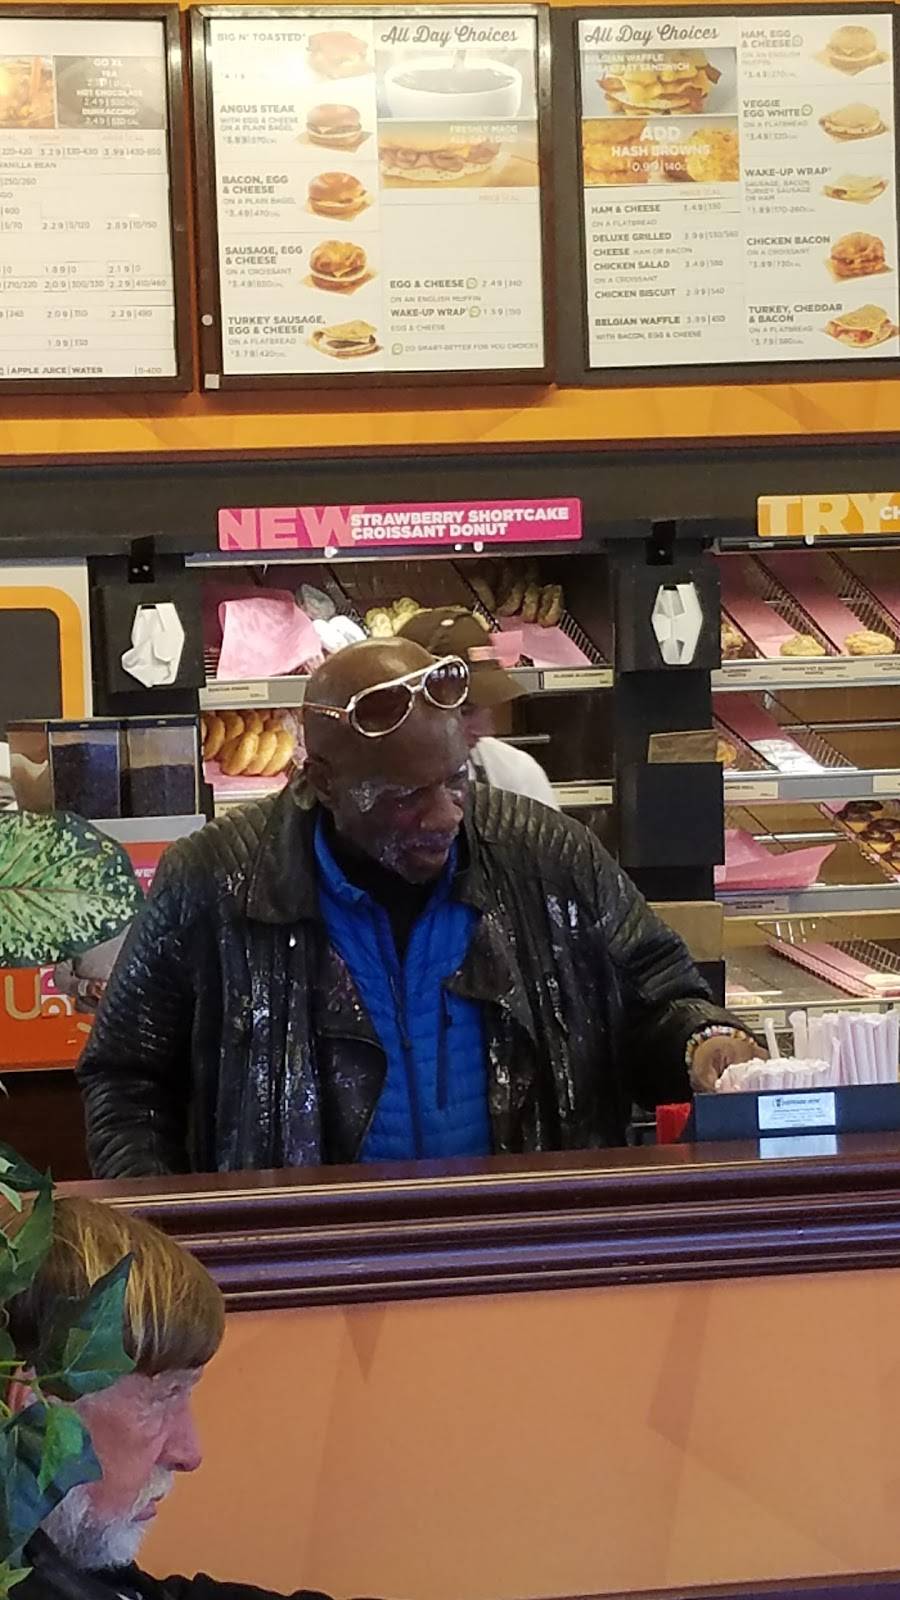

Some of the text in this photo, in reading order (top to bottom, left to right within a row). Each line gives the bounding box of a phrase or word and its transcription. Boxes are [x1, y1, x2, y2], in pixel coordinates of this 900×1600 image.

[381, 25, 519, 48] All Day Choices
[584, 24, 719, 46] All Day Choices
[770, 30, 791, 38] EGG
[750, 39, 792, 48] CHEESE
[743, 100, 780, 108] VEGGIE
[220, 105, 295, 114] ANGUS STEAK
[743, 109, 800, 118] EGG WHITE
[639, 126, 681, 142] ADD
[611, 145, 710, 157] HASH BROWNS
[745, 168, 793, 177] WAKE-UP
[266, 176, 288, 184] EGG
[222, 186, 274, 194] & CHEESE
[591, 204, 661, 214] HAM & CHEESE
[592, 232, 672, 243] DELUXE GRILLED
[747, 236, 830, 246] CHICKEN BACON
[281, 246, 303, 254] EGG
[593, 248, 630, 257] CHEESE
[226, 256, 277, 265] & CHEESE
[593, 261, 670, 271] CHICKEN SALAD
[390, 280, 465, 288] EGG & CHEESE
[595, 288, 677, 299] CHICKEN BISCUIT
[793, 303, 842, 312] CHEDDAR
[390, 308, 435, 317] WAKE-UP
[228, 316, 271, 325] TURKEY
[595, 316, 681, 327] BELGIAN WAFFLE
[749, 314, 794, 323] & BACON
[228, 325, 304, 335] EGG & CHEESE
[351, 507, 569, 527] STRAWBERRY SHORTCAKE
[759, 495, 893, 536] TRY
[219, 507, 365, 550] NEW
[351, 523, 508, 540] CROISSANT DONUT
